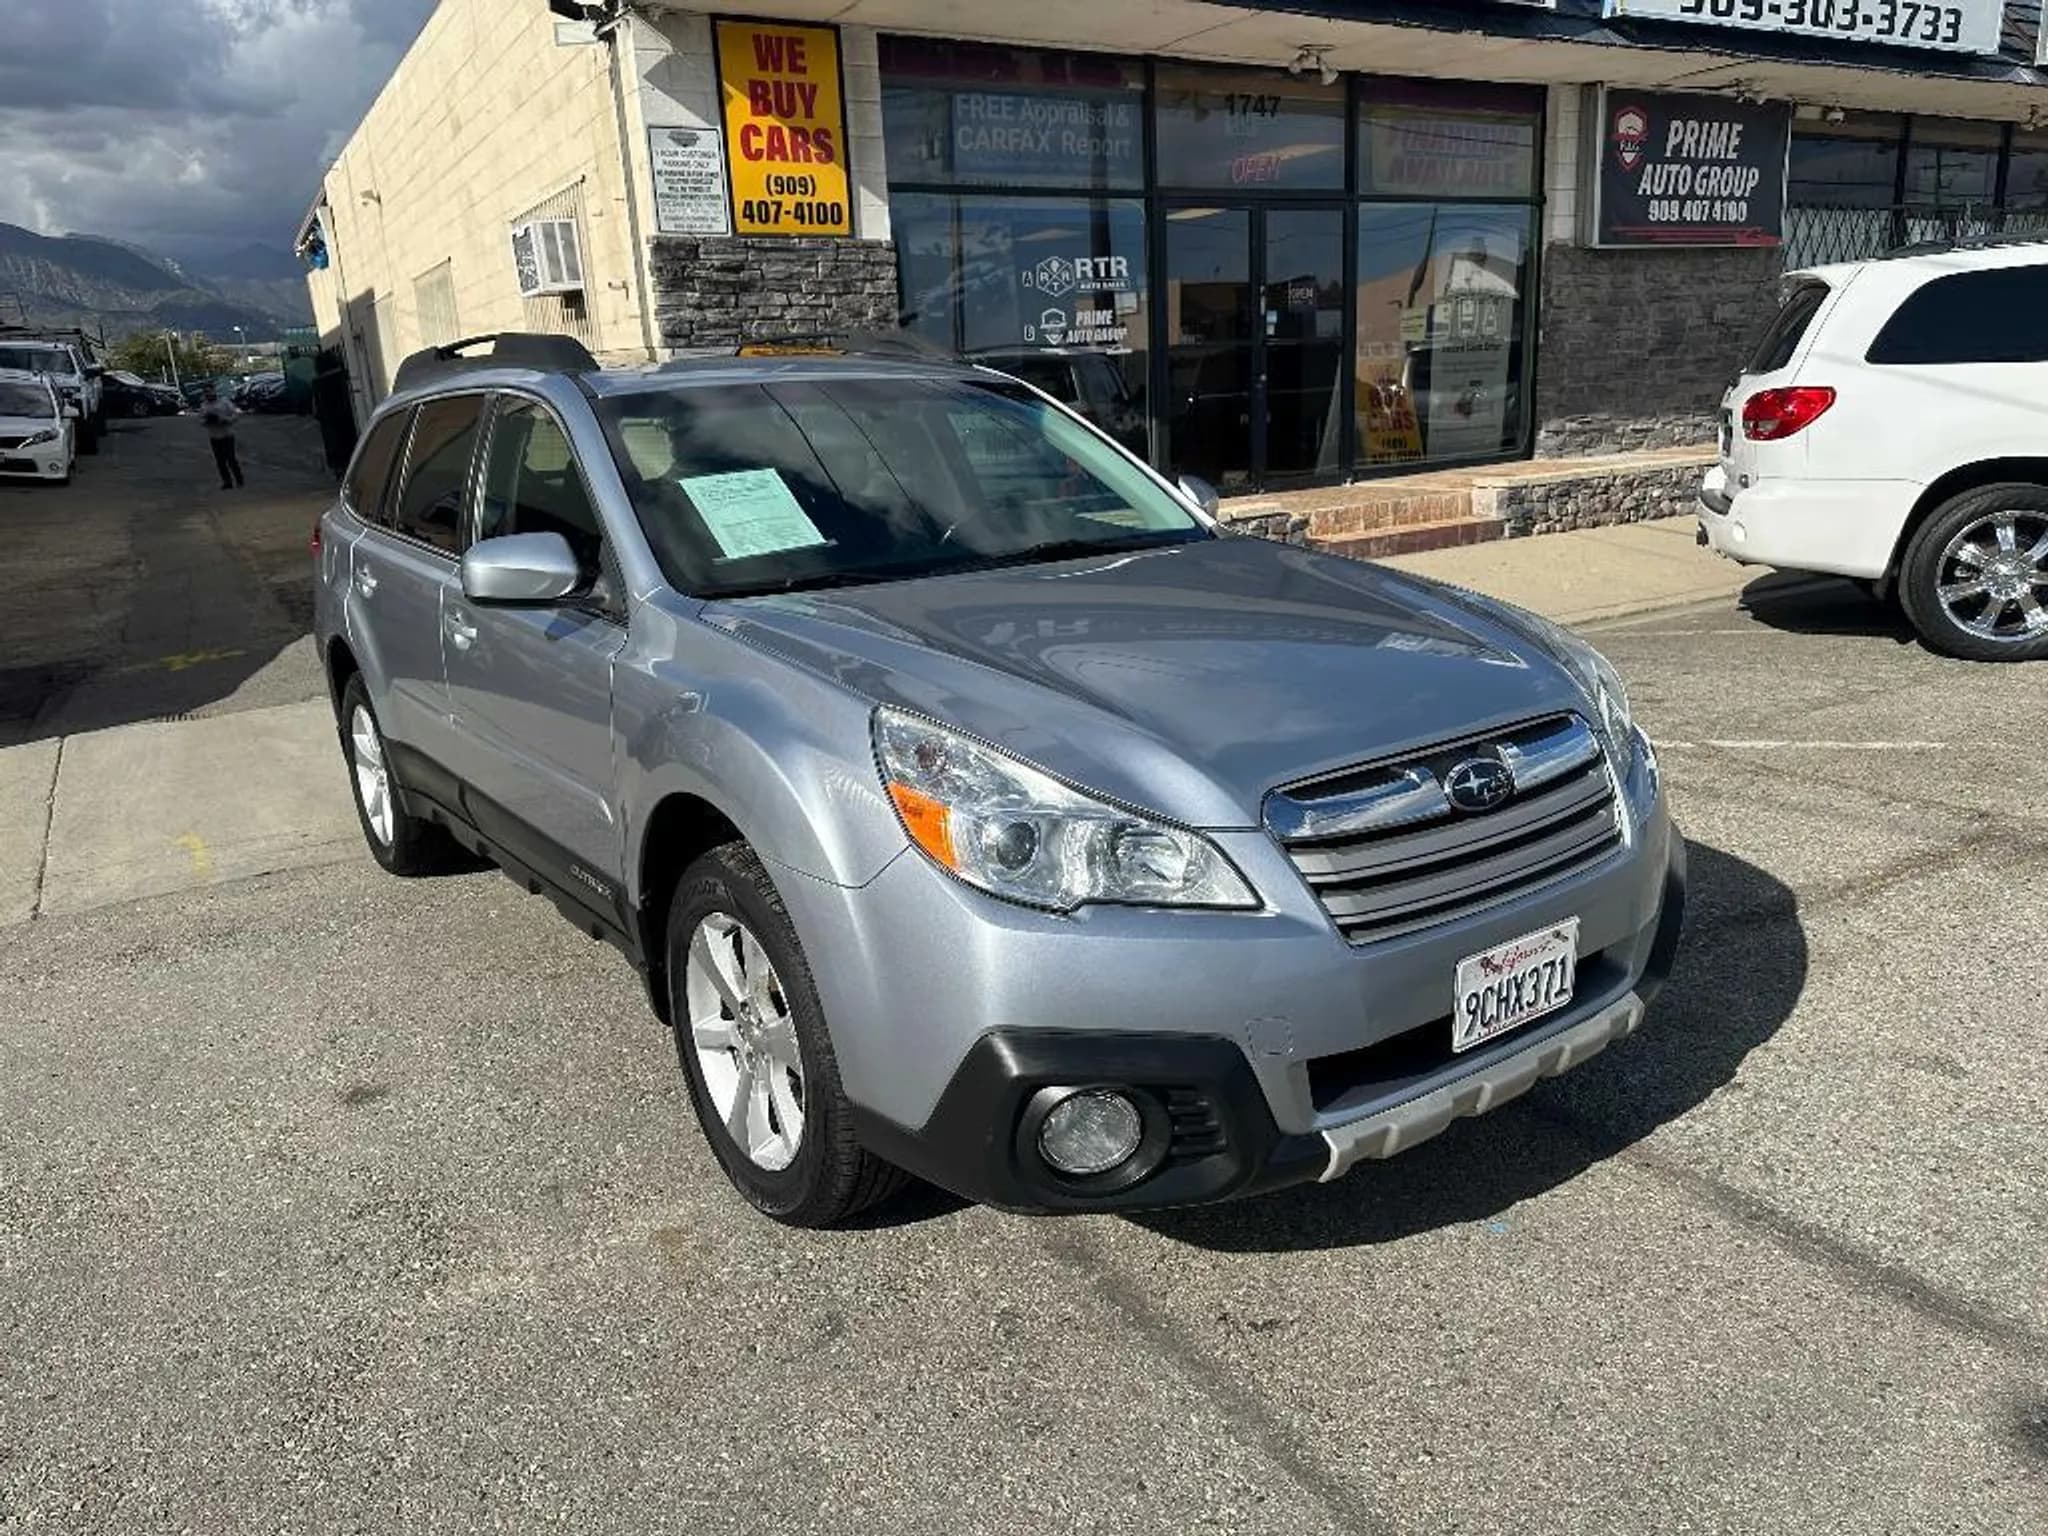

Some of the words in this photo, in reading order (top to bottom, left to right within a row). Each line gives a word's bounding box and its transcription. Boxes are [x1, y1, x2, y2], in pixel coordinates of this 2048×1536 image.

[752, 34, 807, 74] WE
[749, 79, 817, 119] BUY
[957, 93, 1014, 121] FREE
[1019, 97, 1114, 130] Appraisal
[1224, 93, 1281, 117] 1747
[740, 124, 834, 164] CARS
[957, 126, 1050, 153] CARFAX
[1061, 130, 1131, 158] Report
[1664, 119, 1743, 159] PRIME
[1231, 157, 1280, 184] OPEN
[1637, 164, 1692, 195] AUTO
[1694, 165, 1759, 197] GROUP
[766, 174, 816, 197] (909)
[742, 200, 843, 226] 407-4100
[1649, 200, 1679, 221] 909
[1682, 200, 1709, 221] 407
[1712, 200, 1747, 222] 4100
[1075, 256, 1128, 278] RTR
[1076, 310, 1113, 326] PRIME
[1066, 330, 1093, 343] AUTO
[1094, 327, 1128, 341] GROUP
[1465, 955, 1568, 1037] 9CHX371
